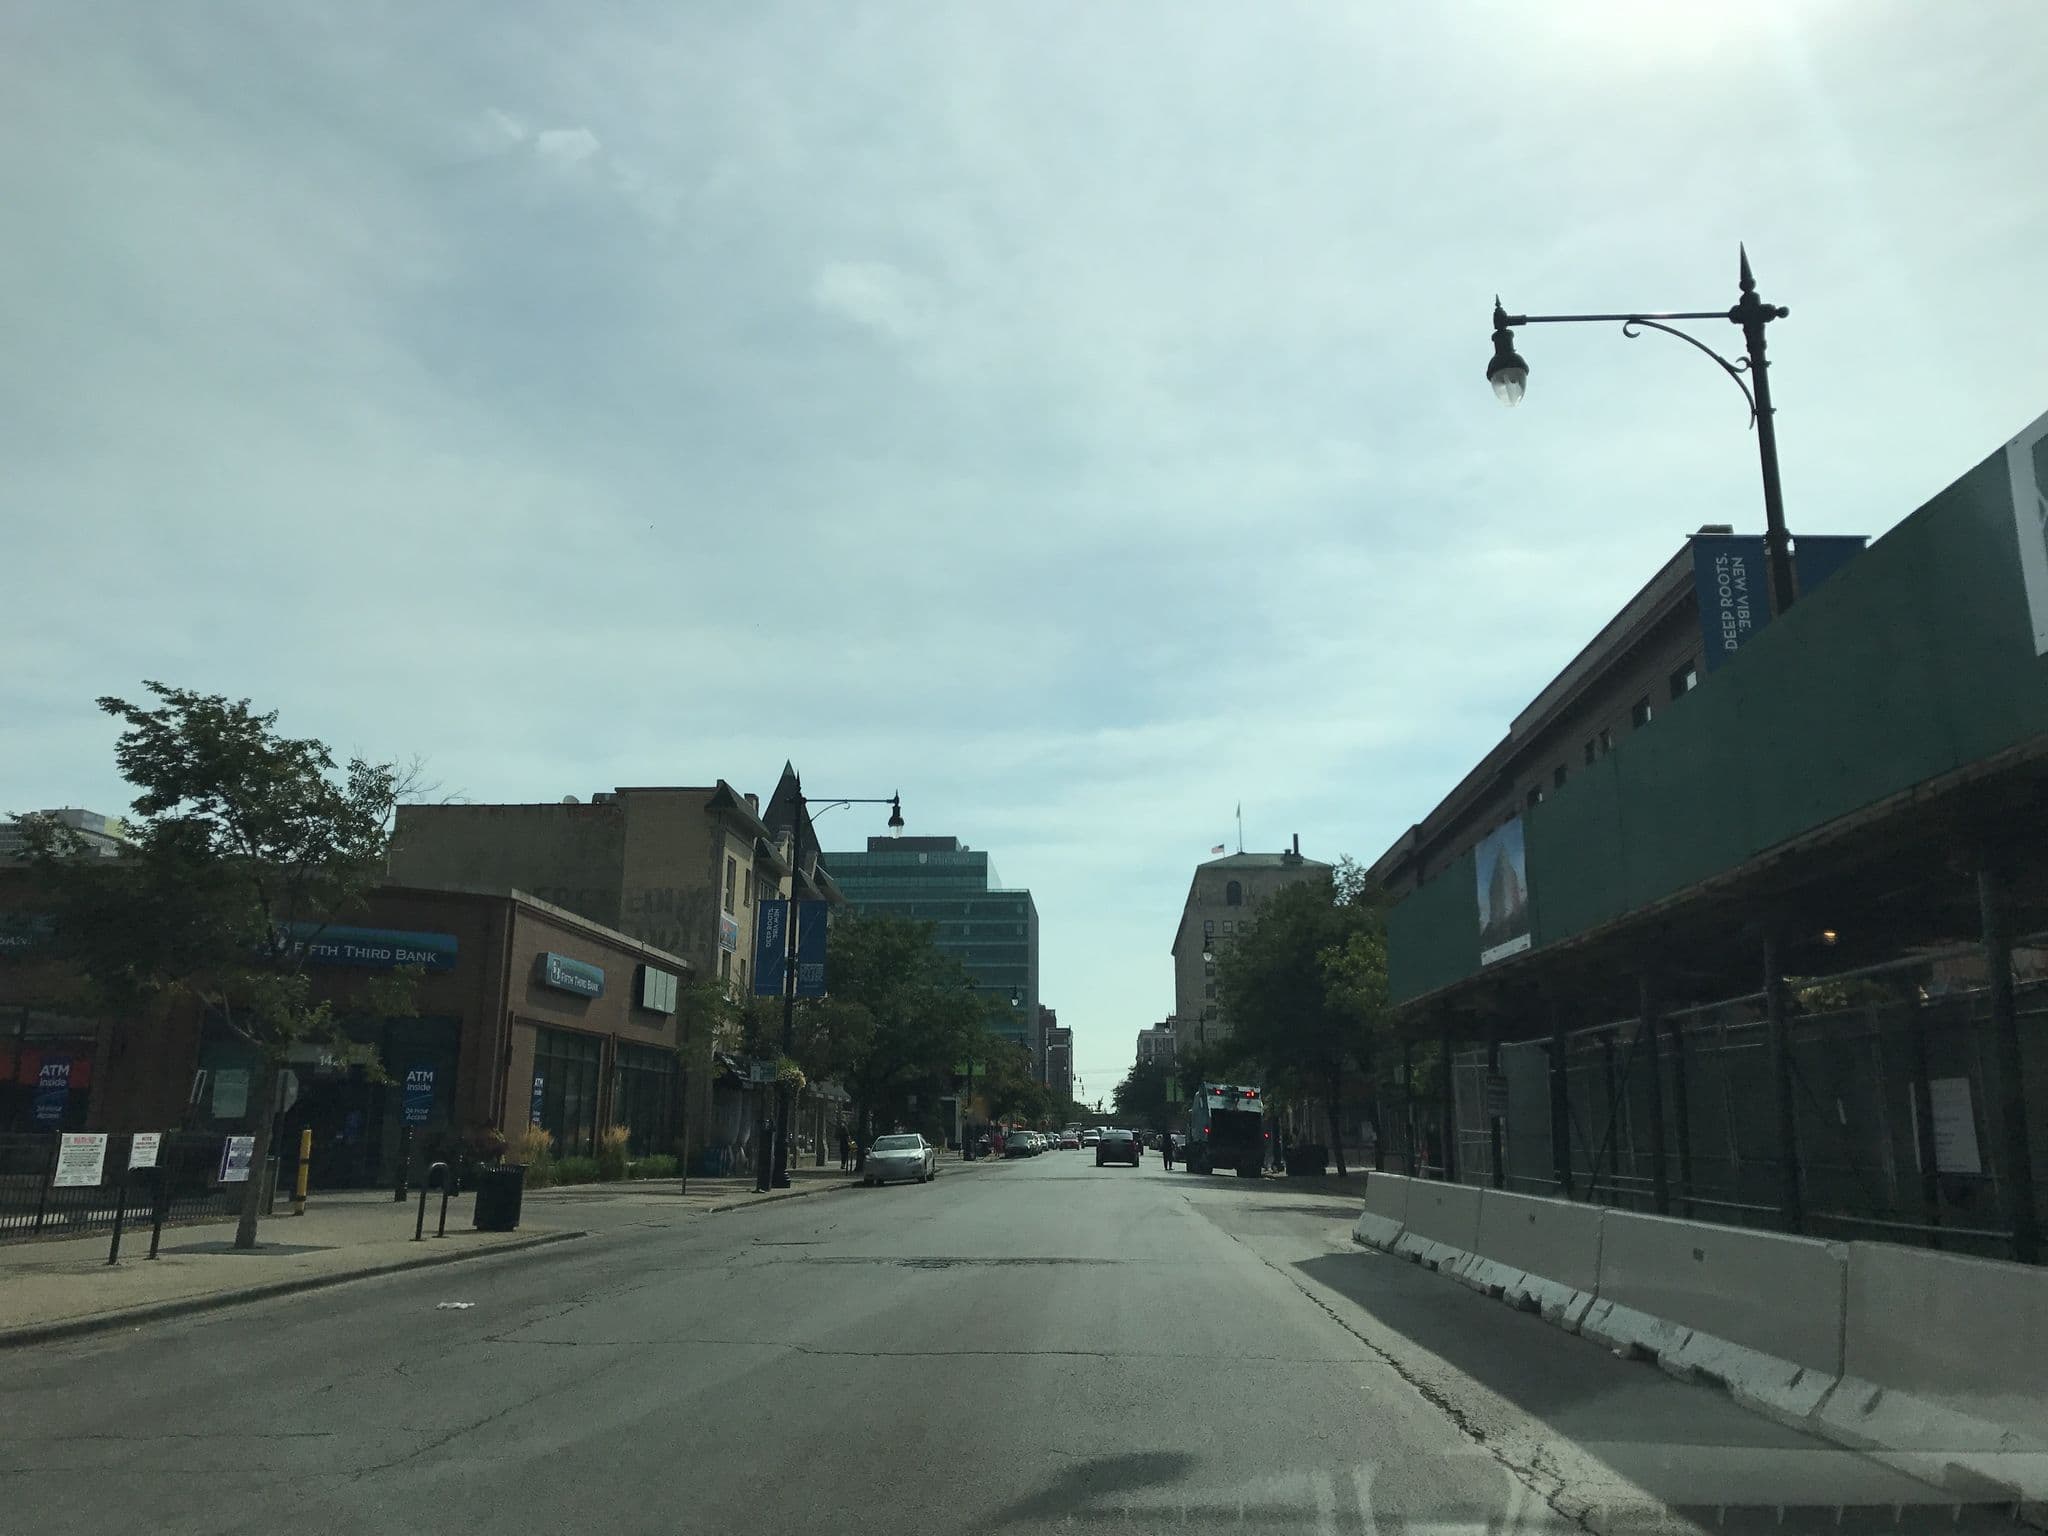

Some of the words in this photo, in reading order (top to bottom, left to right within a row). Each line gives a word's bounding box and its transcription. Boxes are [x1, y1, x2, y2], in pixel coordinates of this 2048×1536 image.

[1716, 552, 1734, 607] ROOTS.
[1732, 557, 1748, 591] NEW
[1721, 610, 1738, 650] DEEP
[294, 942, 338, 956] FFTH
[344, 945, 391, 960] THIRD
[395, 949, 438, 963] BANK
[39, 1064, 70, 1077] ATM
[406, 1070, 433, 1082] ATM
